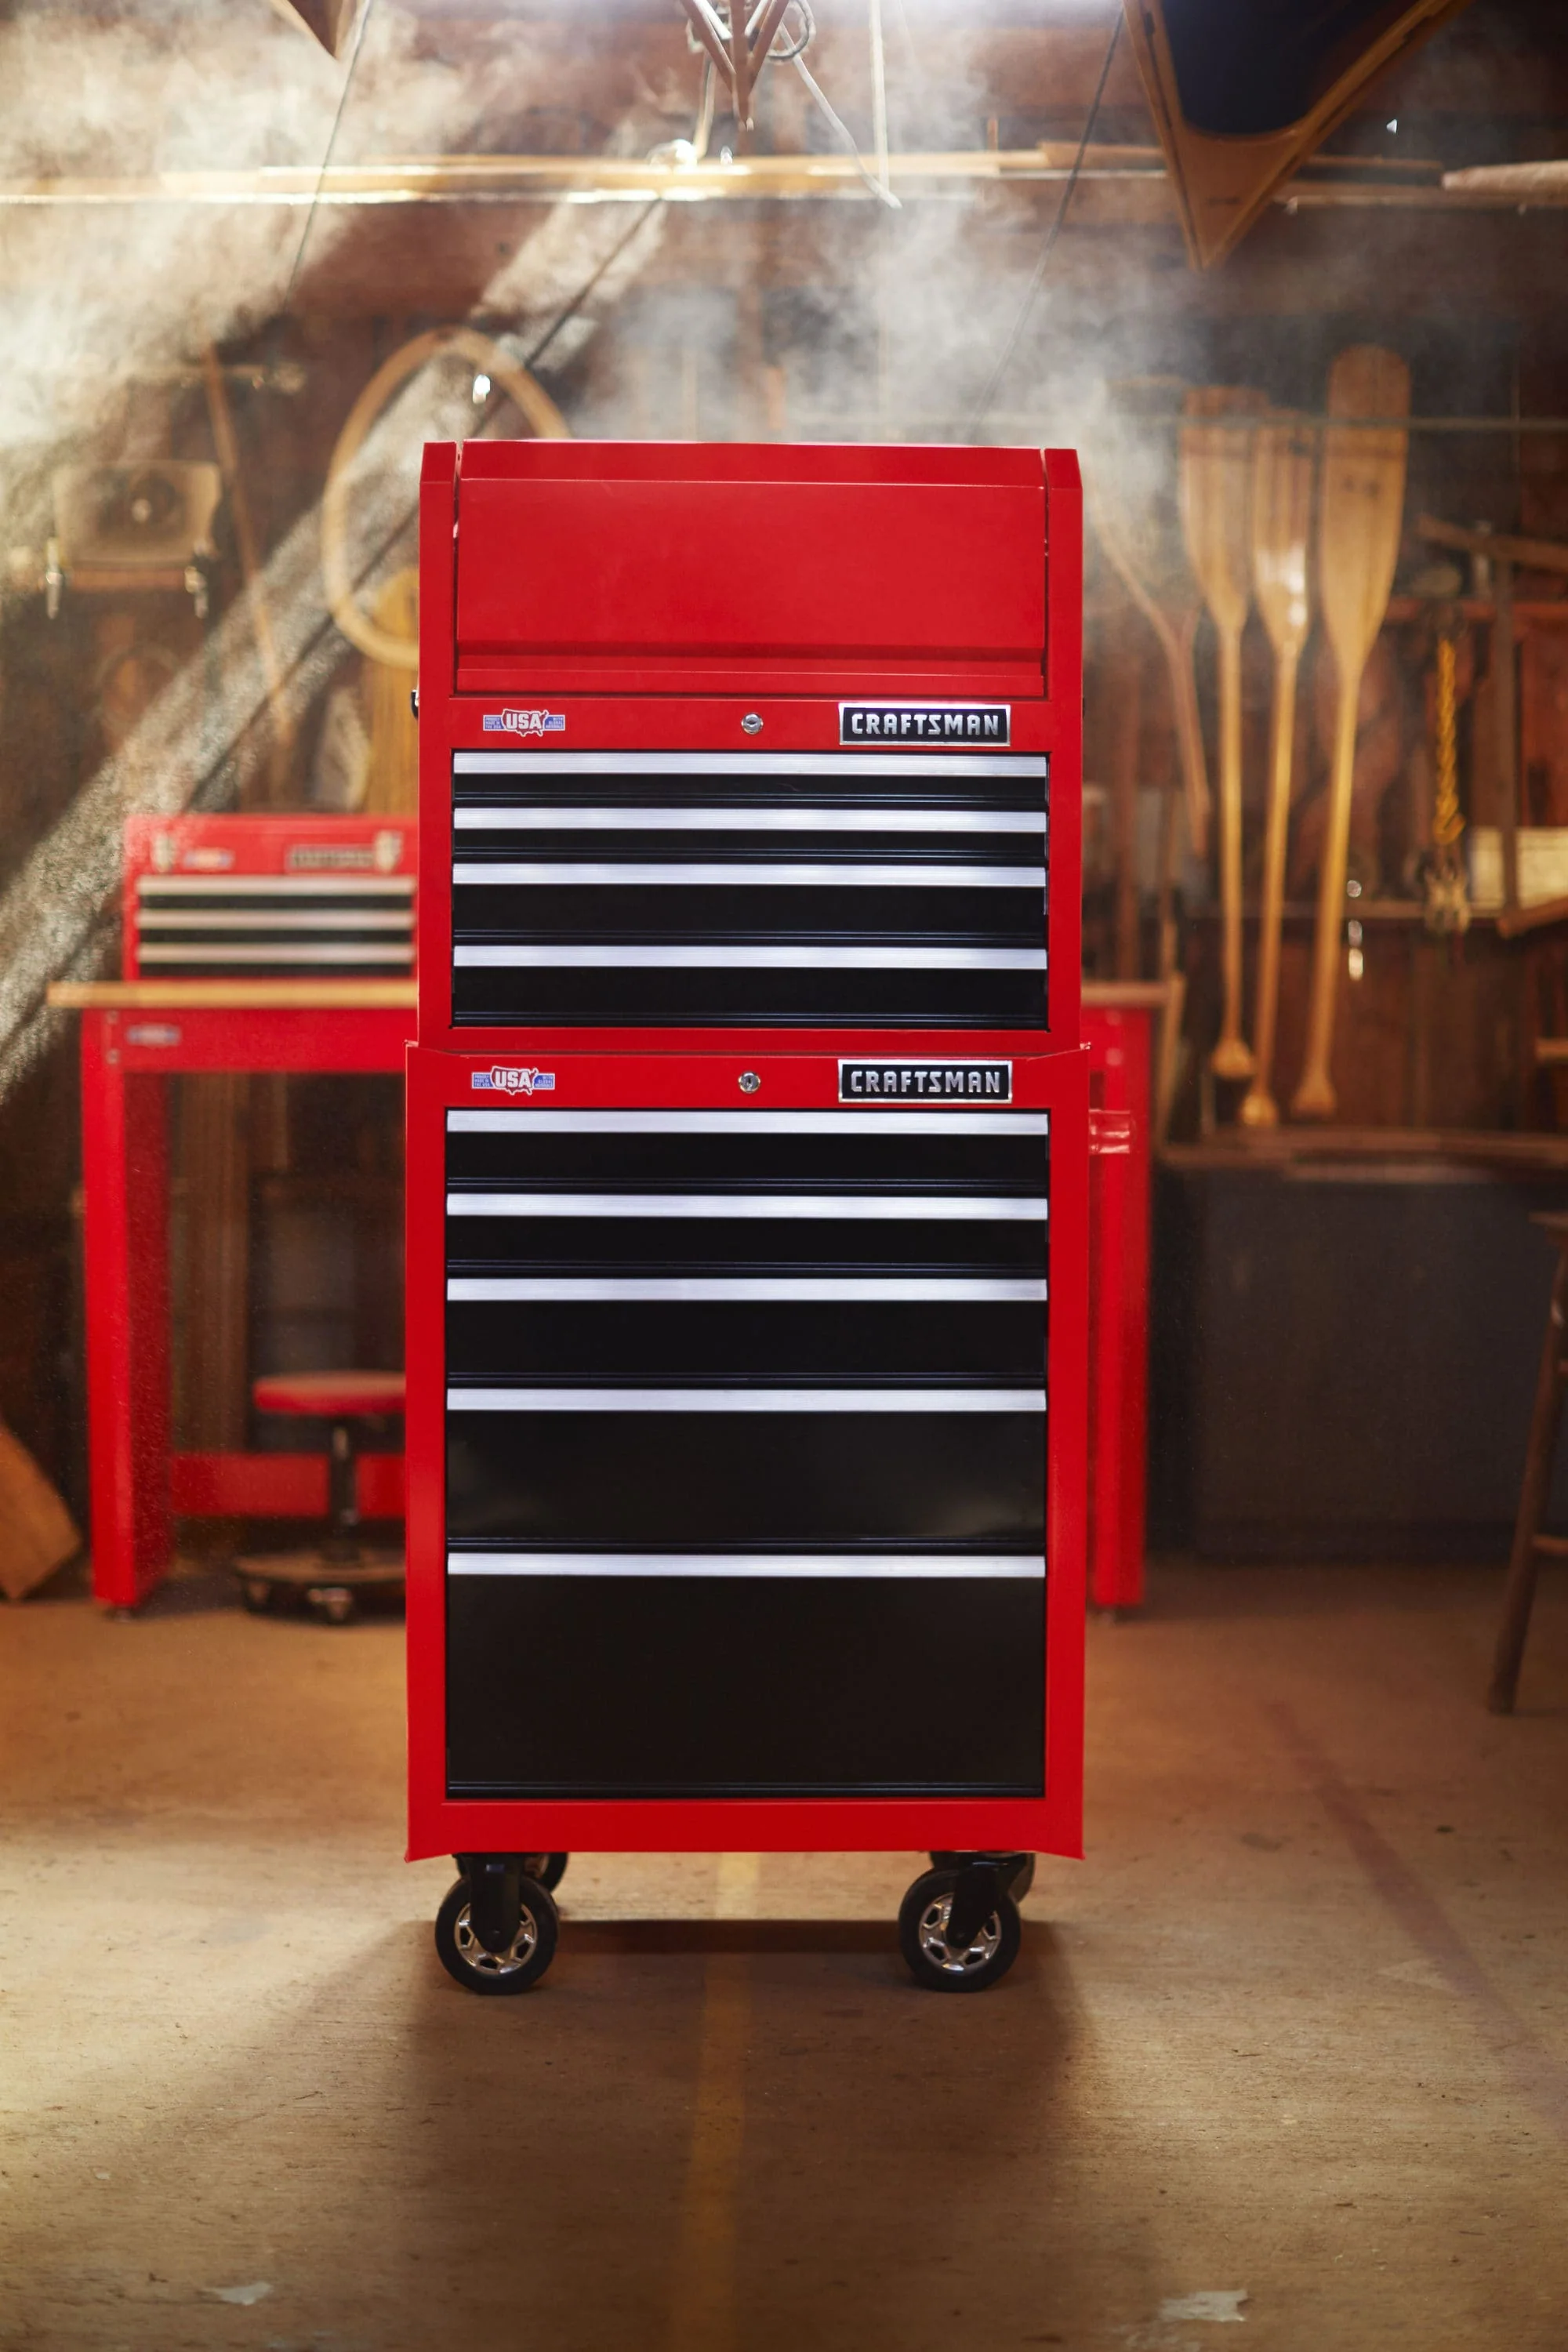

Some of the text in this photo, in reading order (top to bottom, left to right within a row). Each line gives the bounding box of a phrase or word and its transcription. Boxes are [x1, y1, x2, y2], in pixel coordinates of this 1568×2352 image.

[506, 713, 542, 729] USA
[851, 713, 999, 735] CRAFTSMAN
[495, 1071, 532, 1087] USA
[851, 1071, 1000, 1093] CRAFTSMAN
